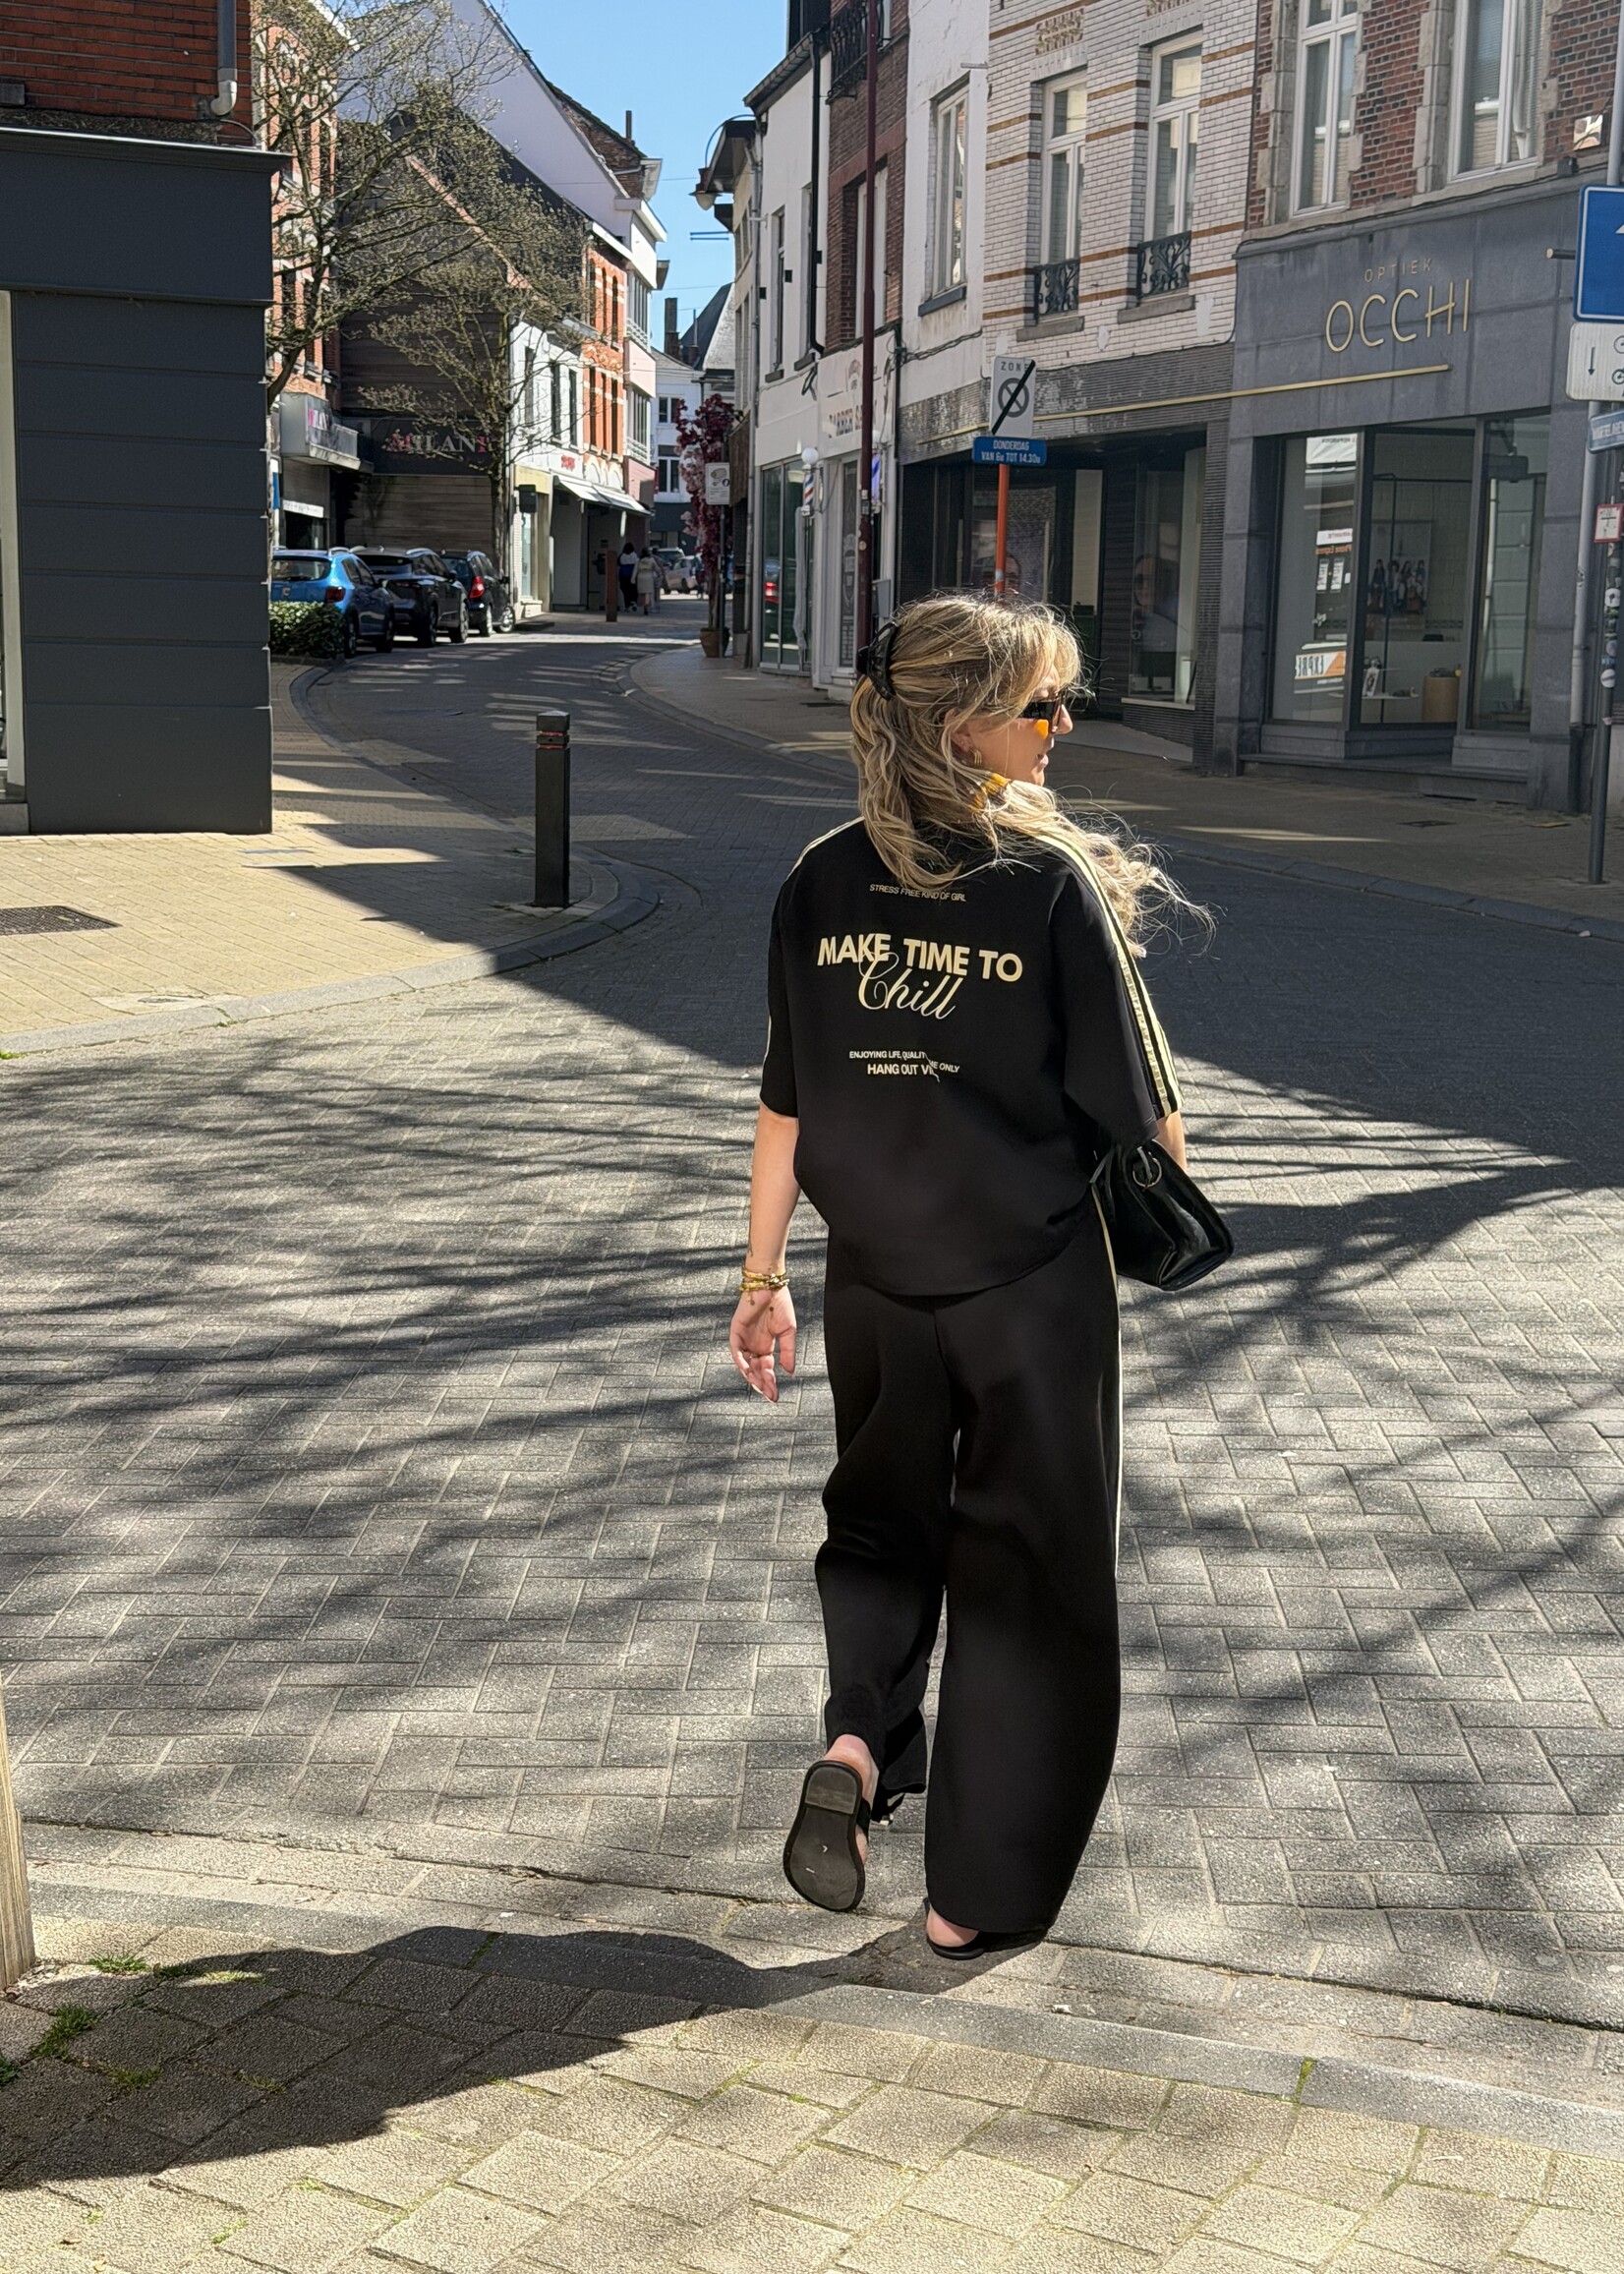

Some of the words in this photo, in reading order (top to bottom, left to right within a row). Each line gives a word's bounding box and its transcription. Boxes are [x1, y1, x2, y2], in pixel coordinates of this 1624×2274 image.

[1363, 258, 1433, 283] OPTIEK
[1325, 278, 1471, 353] OCCHI
[1001, 361, 1030, 373] ZONE
[993, 439, 1030, 451] DONDERDAG
[981, 451, 995, 461] VAN
[1006, 452, 1017, 462] TOT
[869, 884, 899, 895] STRESS
[900, 888, 921, 898] FREE
[921, 891, 939, 900] KIND
[940, 892, 950, 901] OF
[951, 893, 966, 902] GIRL
[817, 933, 892, 966] MAKE
[902, 938, 970, 976] TIME
[978, 950, 1023, 982] TO
[858, 952, 964, 1020] Chill
[848, 1050, 887, 1059] ENJOYING
[901, 1051, 926, 1061] QUALIT
[939, 1063, 960, 1074] ONLY
[867, 1064, 899, 1075] HANG
[900, 1064, 919, 1076] OUT
